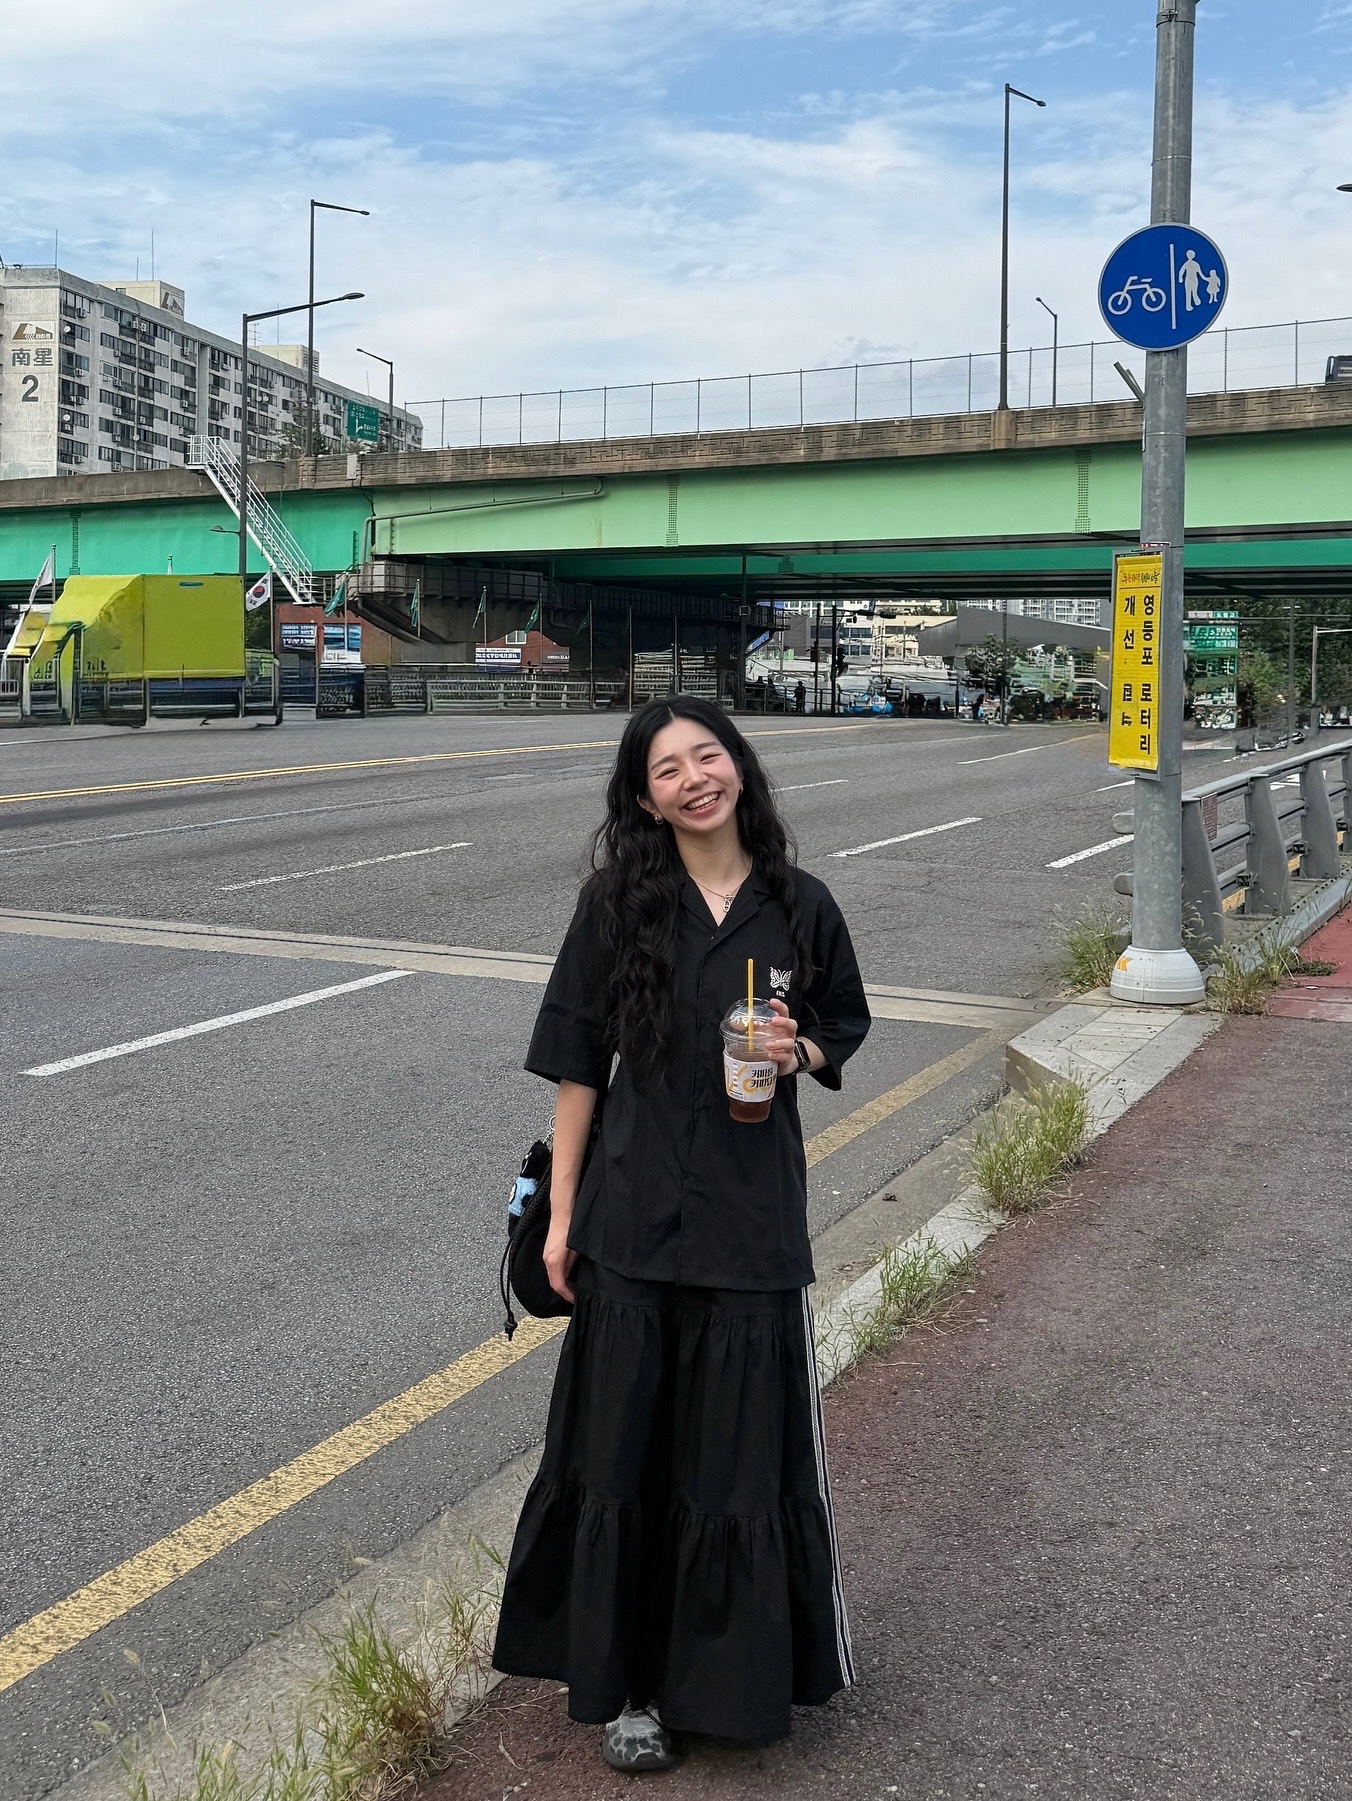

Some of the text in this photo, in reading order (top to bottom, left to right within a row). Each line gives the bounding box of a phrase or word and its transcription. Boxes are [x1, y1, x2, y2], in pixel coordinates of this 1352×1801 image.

[11, 347, 53, 366] 南星
[21, 374, 39, 402] 2
[1123, 594, 1136, 650] 개선
[1139, 594, 1155, 755] 영등포 로터리
